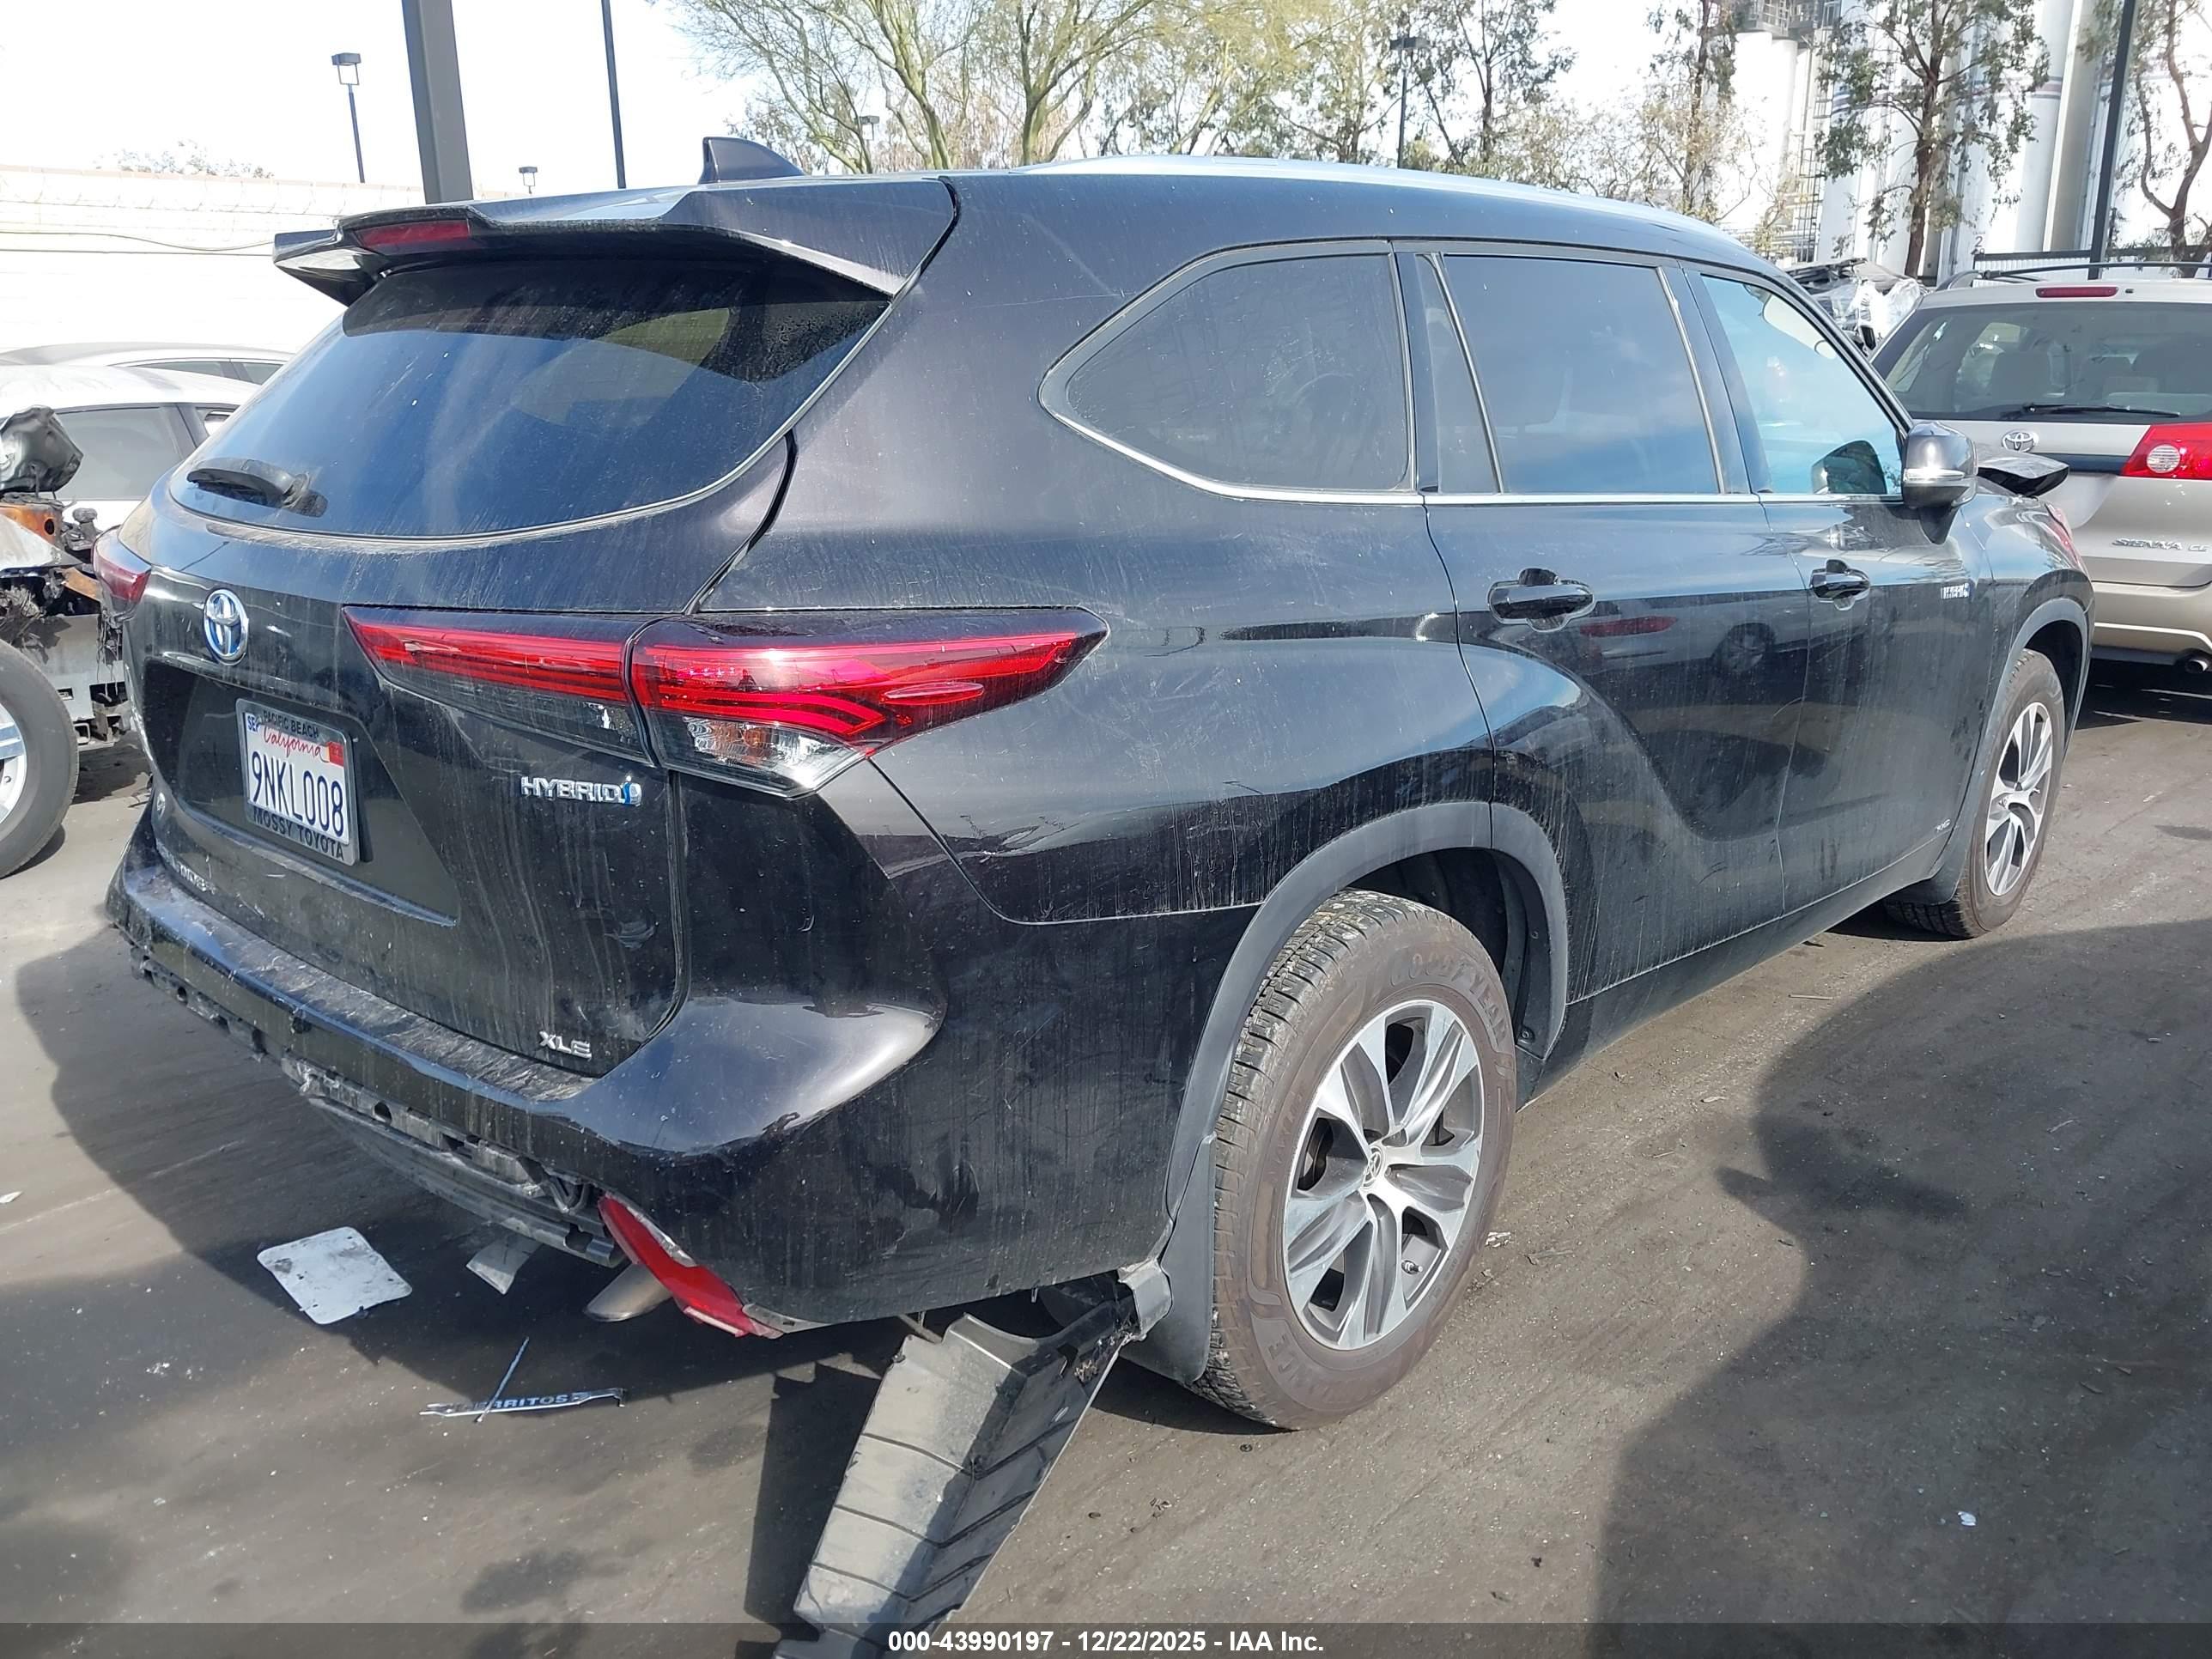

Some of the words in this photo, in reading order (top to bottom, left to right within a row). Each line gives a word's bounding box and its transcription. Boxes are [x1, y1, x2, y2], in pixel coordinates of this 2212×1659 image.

[264, 710, 289, 730] PACIFIC
[290, 720, 319, 738] BEACH
[263, 726, 322, 757] California
[252, 750, 344, 837] 9NKL008
[520, 776, 628, 805] HYBRID
[253, 807, 294, 836] MOSSY
[296, 825, 344, 860] TOYOTA
[539, 1030, 592, 1059] XLE
